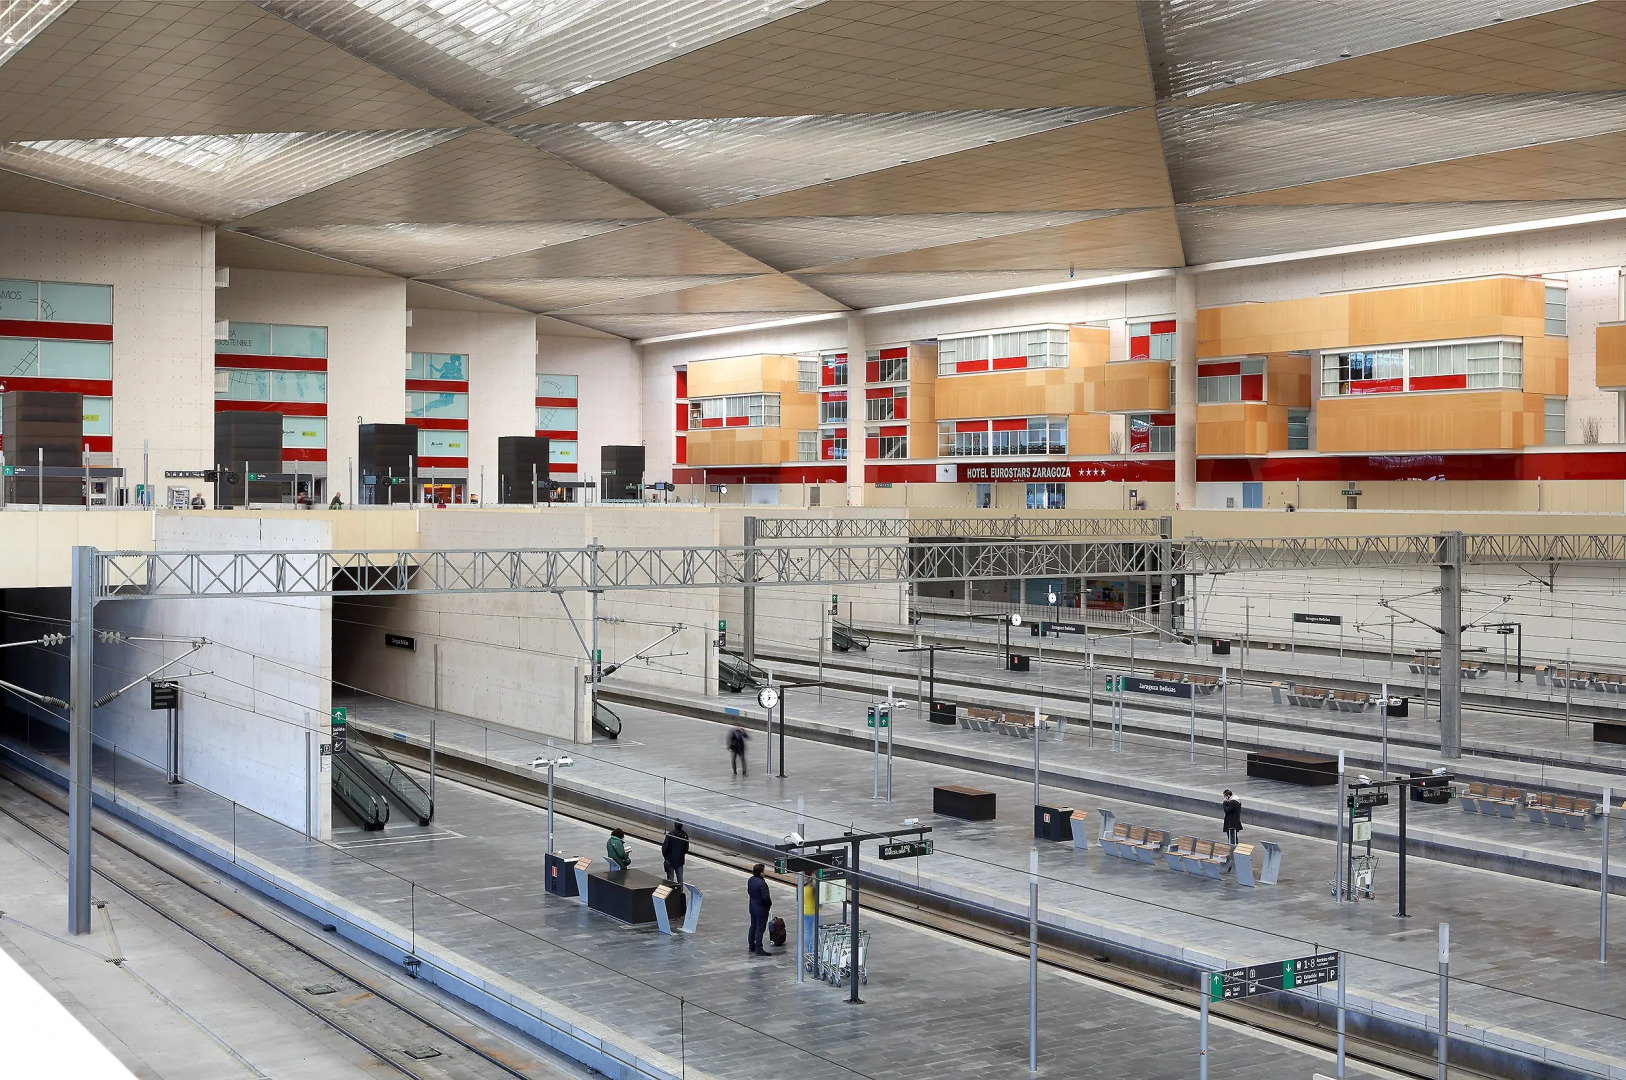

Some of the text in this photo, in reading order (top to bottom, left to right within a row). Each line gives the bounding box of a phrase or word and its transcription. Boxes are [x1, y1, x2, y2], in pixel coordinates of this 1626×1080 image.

[967, 466, 1071, 478] HOTEL EUROSTARS ZARAGOZA
[1139, 683, 1159, 691] Zaragoza
[1331, 970, 1335, 979] P
